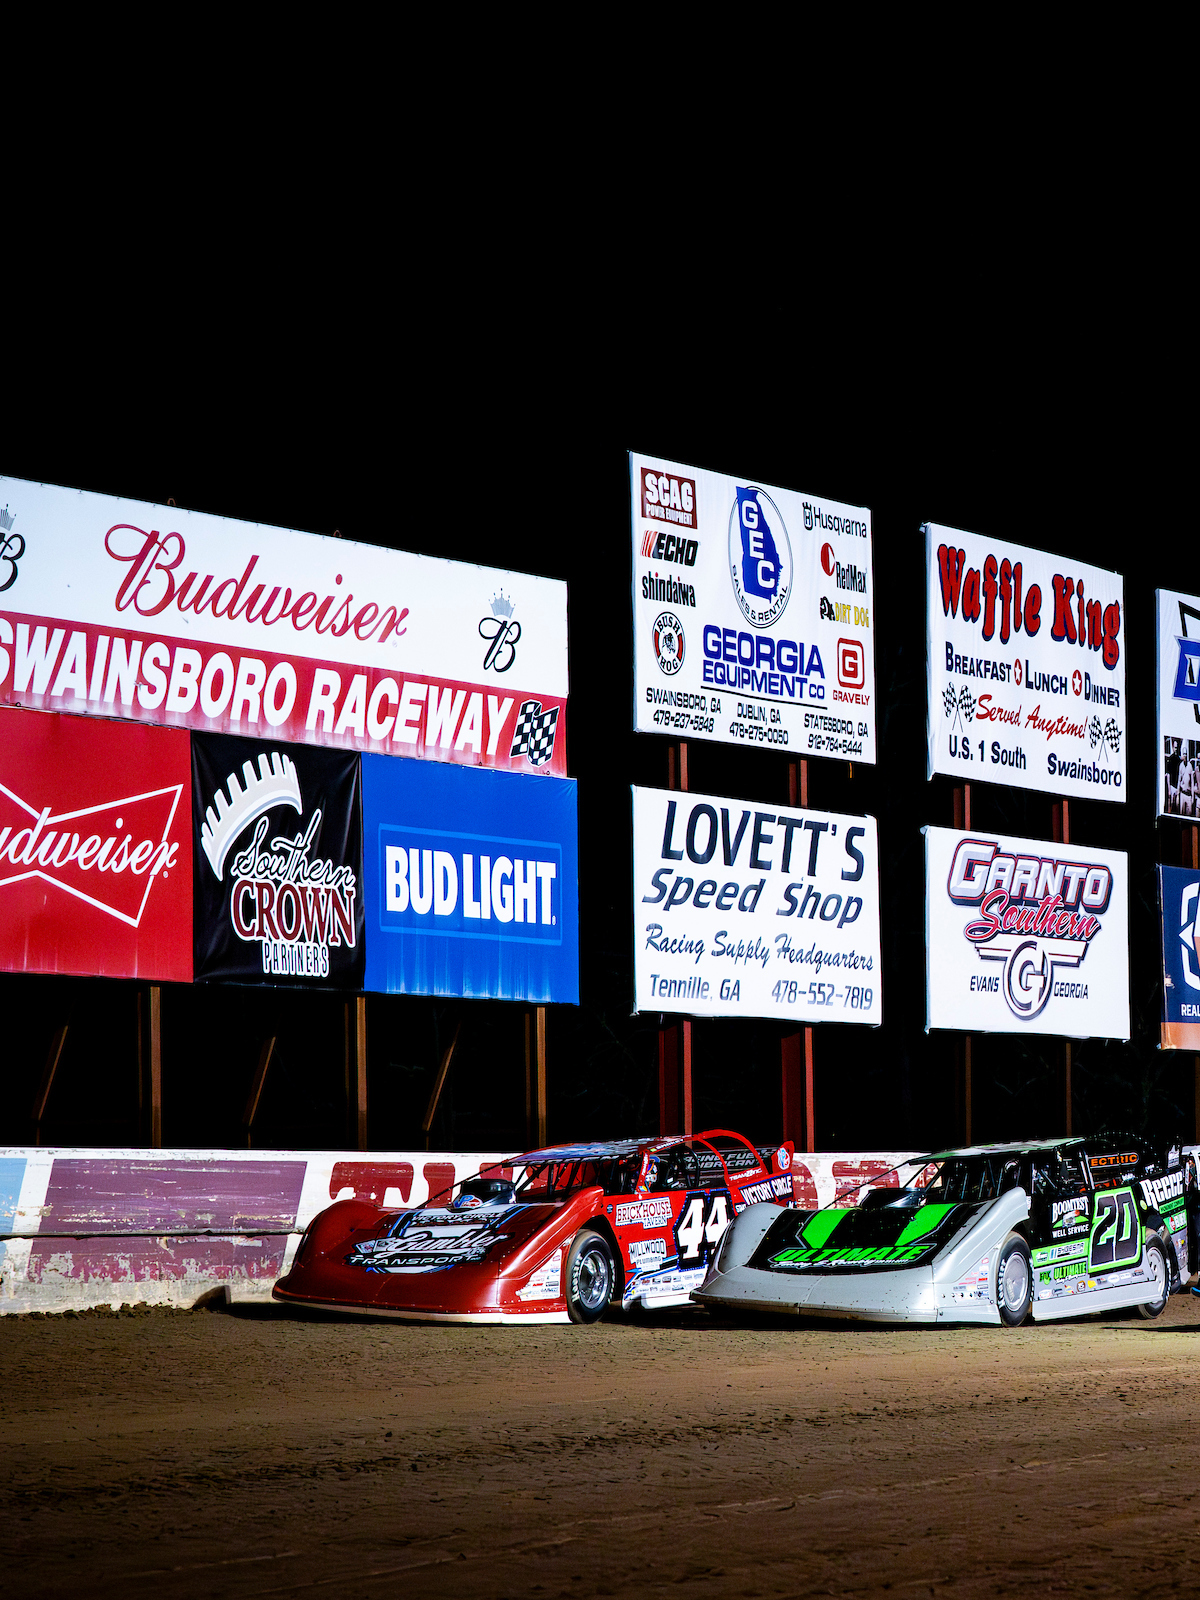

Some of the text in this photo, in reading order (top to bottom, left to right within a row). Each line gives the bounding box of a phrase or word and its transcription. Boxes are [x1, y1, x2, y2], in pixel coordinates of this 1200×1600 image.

[645, 473, 693, 512] SCAG
[813, 506, 868, 538] Husqvarna
[655, 531, 699, 567] ECHO
[104, 524, 409, 643] Budweiser
[642, 571, 696, 608] shindaiwa
[836, 561, 868, 594] RedMax
[757, 584, 789, 623] RENTAL
[835, 602, 869, 628] DIRT DOG
[937, 543, 1120, 671] Waffle King
[658, 612, 680, 635] BUSH
[660, 658, 678, 672] HOG
[703, 624, 825, 679] GEORGIA
[703, 660, 825, 699] EQUIPMENT CO
[945, 641, 1119, 708] BREAKFAST LUNCH DINNER
[307, 666, 514, 755] RACEWAY
[710, 698, 721, 714] GA
[737, 702, 781, 725] DUBLIN, GA
[833, 689, 870, 706] GRAVELY
[858, 721, 869, 737] GA
[975, 694, 1088, 741] Served Anytime!
[949, 733, 1122, 787] U.S. 1 South Swainsboro
[231, 808, 355, 888] Southern
[661, 800, 865, 882] LOVETT'S
[385, 844, 556, 924] BUD LIGHT
[947, 838, 1113, 914] GARNTO
[231, 879, 357, 948] CROWN
[642, 868, 863, 929] Speed Shop
[963, 888, 1102, 942] Southern
[262, 942, 330, 977] PARTNERS
[645, 923, 873, 973] Racing Supply Headquarters
[719, 979, 740, 1001] GA
[771, 979, 873, 1010] 478-552-7819
[970, 976, 1088, 999] EVANS GEORGIA
[1181, 1004, 1200, 1017] REAL
[740, 1182, 774, 1205] VICTORY
[771, 1176, 792, 1196] CIRCLE
[617, 1201, 670, 1221] BRICK HOUSE
[644, 1217, 667, 1227] TAVERN
[678, 1197, 730, 1259] 44
[1091, 1192, 1137, 1266] 20
[1052, 1224, 1089, 1238] WELL SERVICE
[350, 1253, 474, 1265] TRANSPORT
[774, 1246, 930, 1261] ULTIMATE
[1054, 1262, 1086, 1280] ULTIMATE
